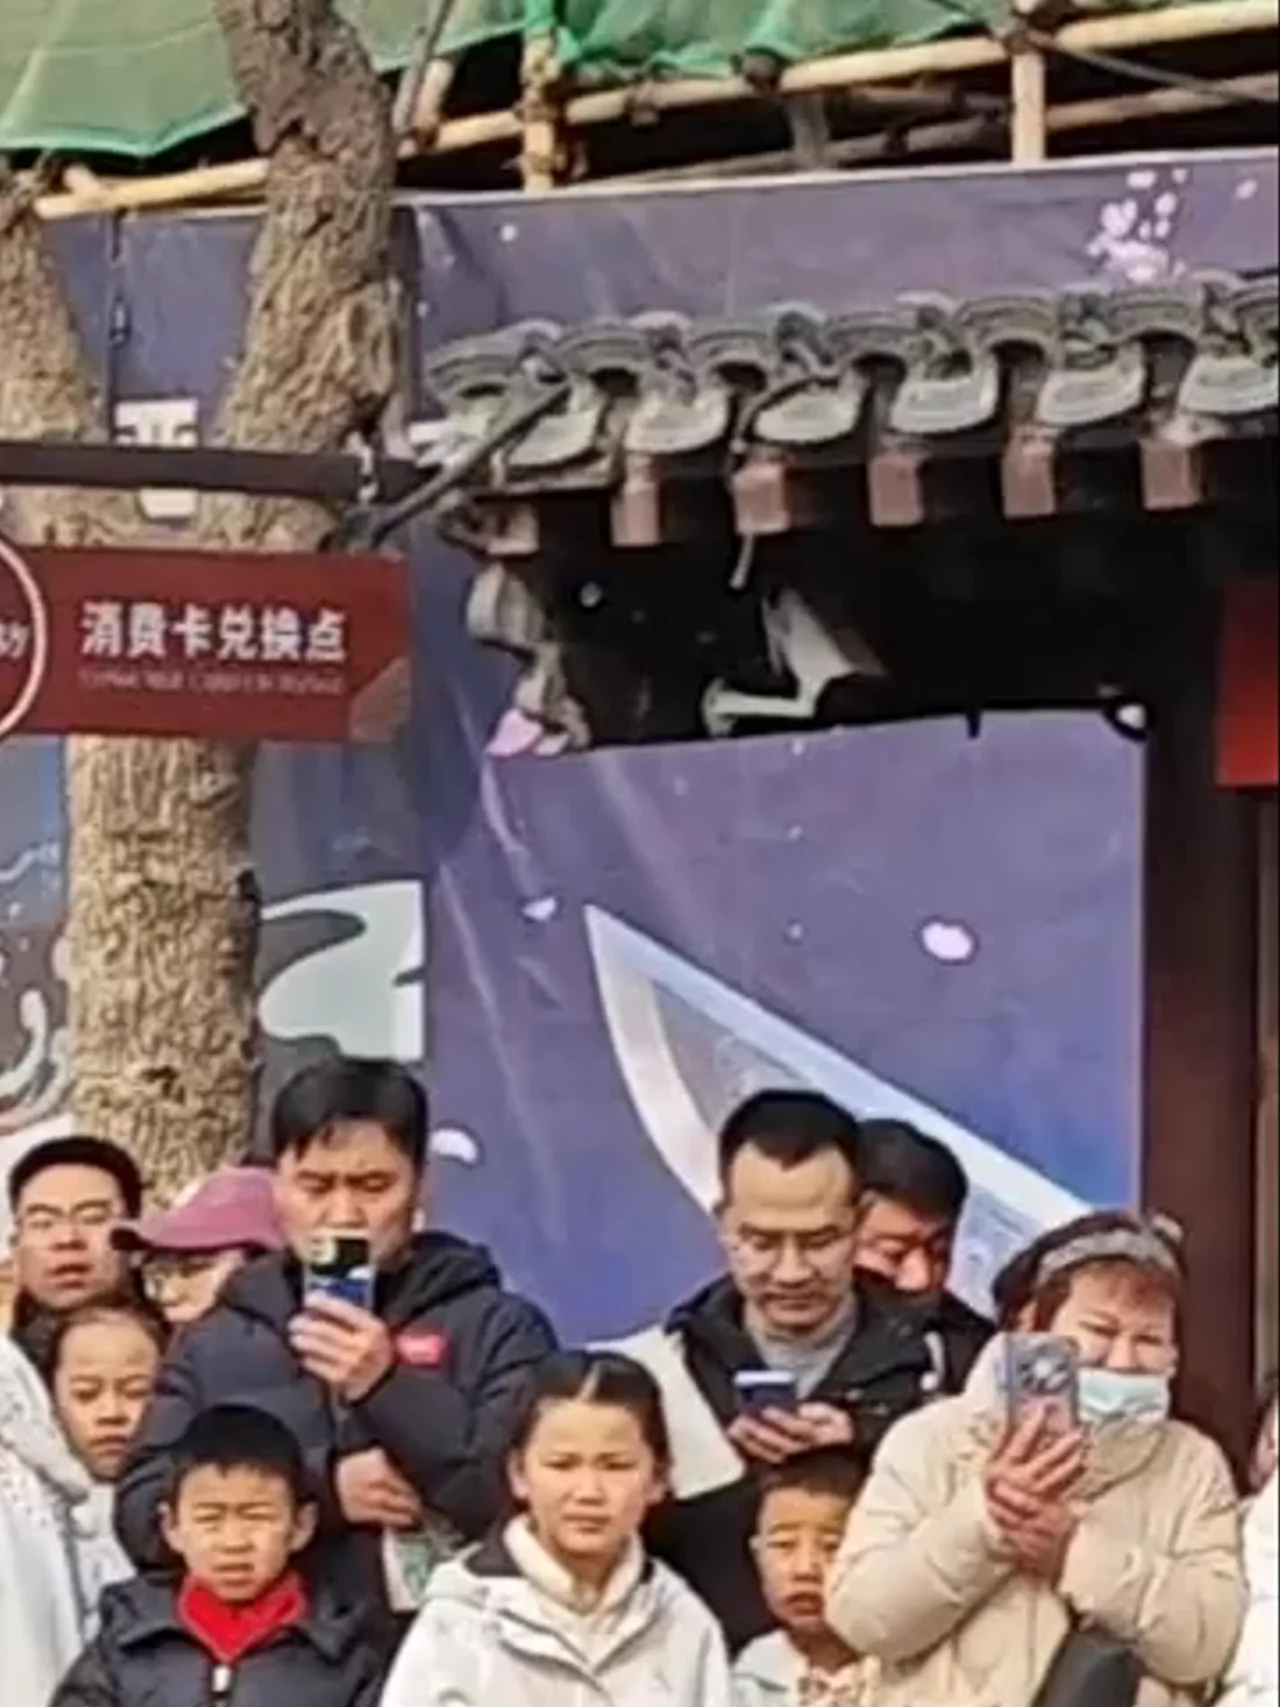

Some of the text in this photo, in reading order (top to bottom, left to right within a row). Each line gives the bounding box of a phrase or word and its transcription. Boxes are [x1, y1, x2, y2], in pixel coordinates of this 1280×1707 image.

[80, 600, 347, 663] 消费卡兑换点
